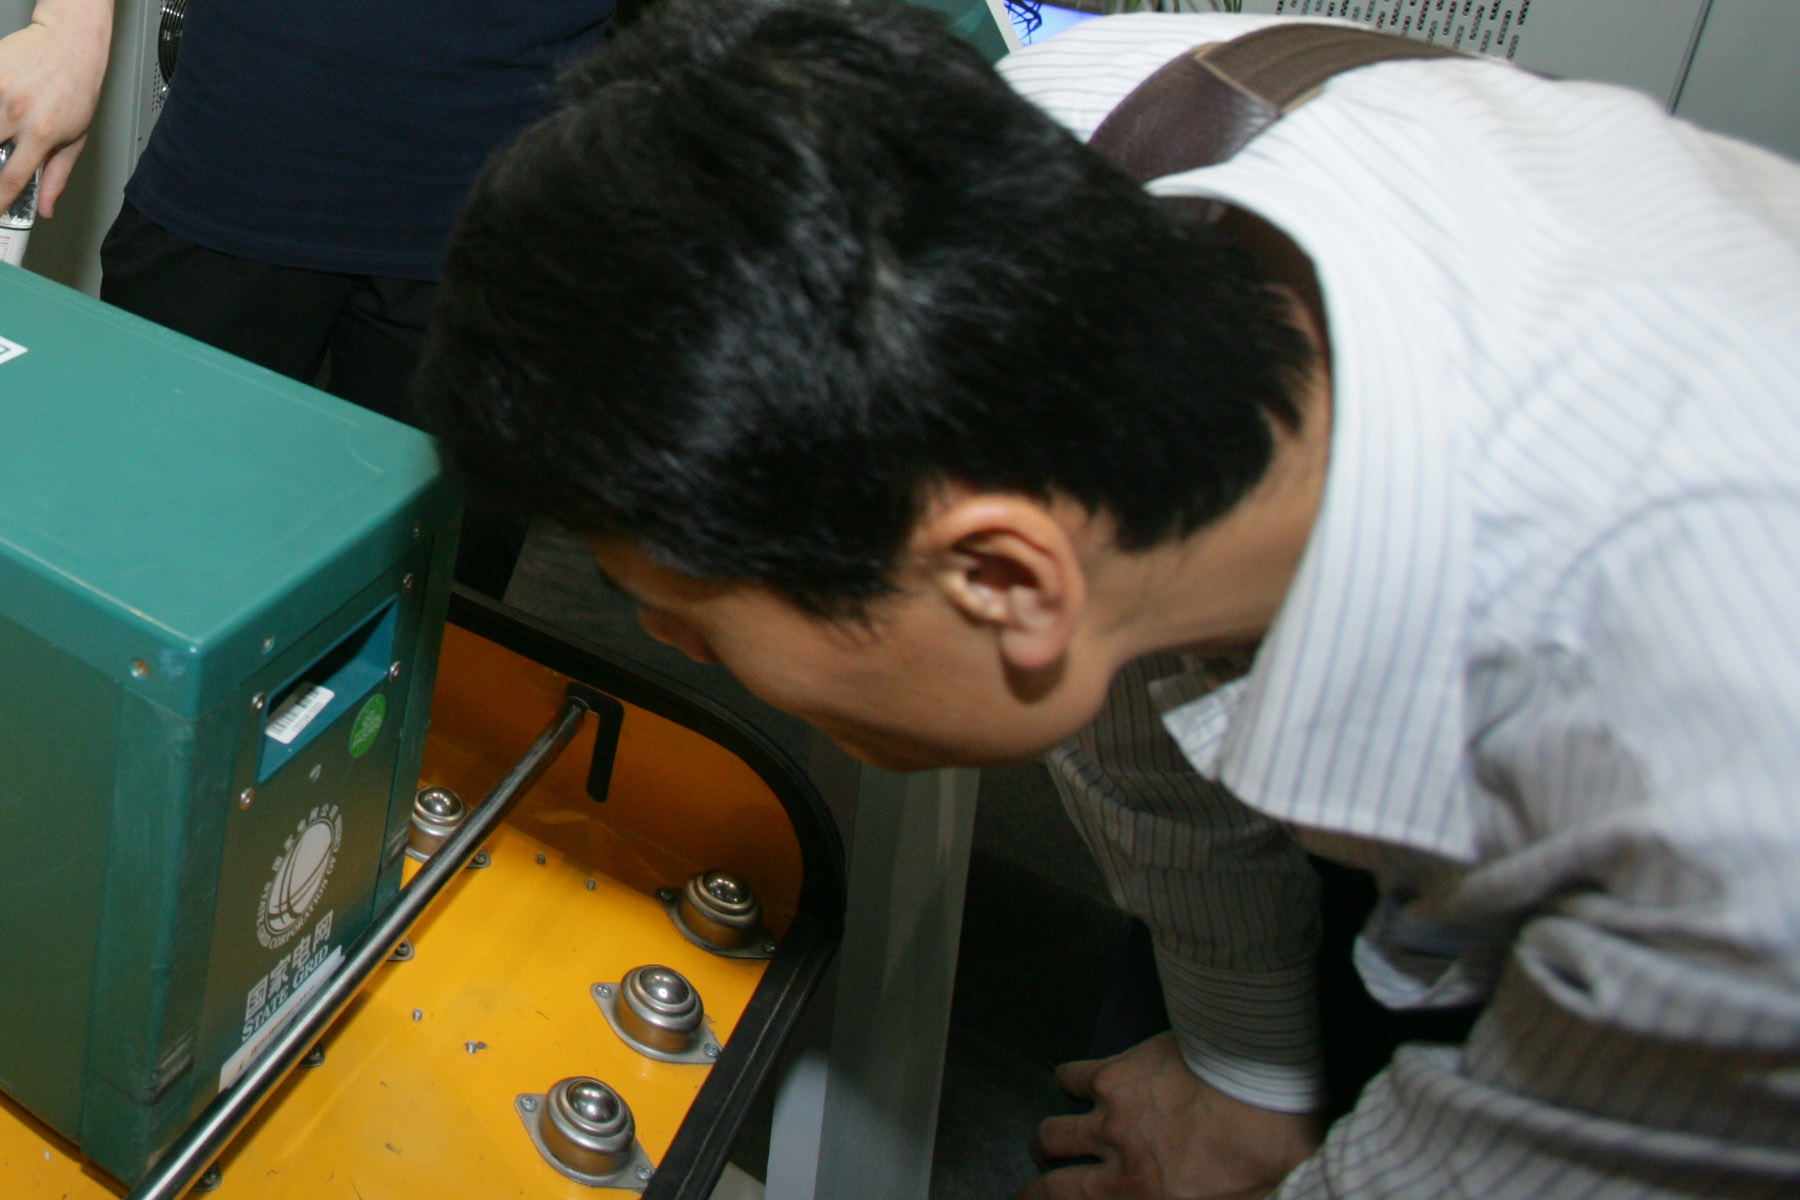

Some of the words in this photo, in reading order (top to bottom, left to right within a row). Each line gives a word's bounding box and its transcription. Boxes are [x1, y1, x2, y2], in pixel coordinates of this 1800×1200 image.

[241, 983, 290, 1043] STATE
[292, 945, 329, 992] GRID
[244, 909, 334, 1023] 国家电网
